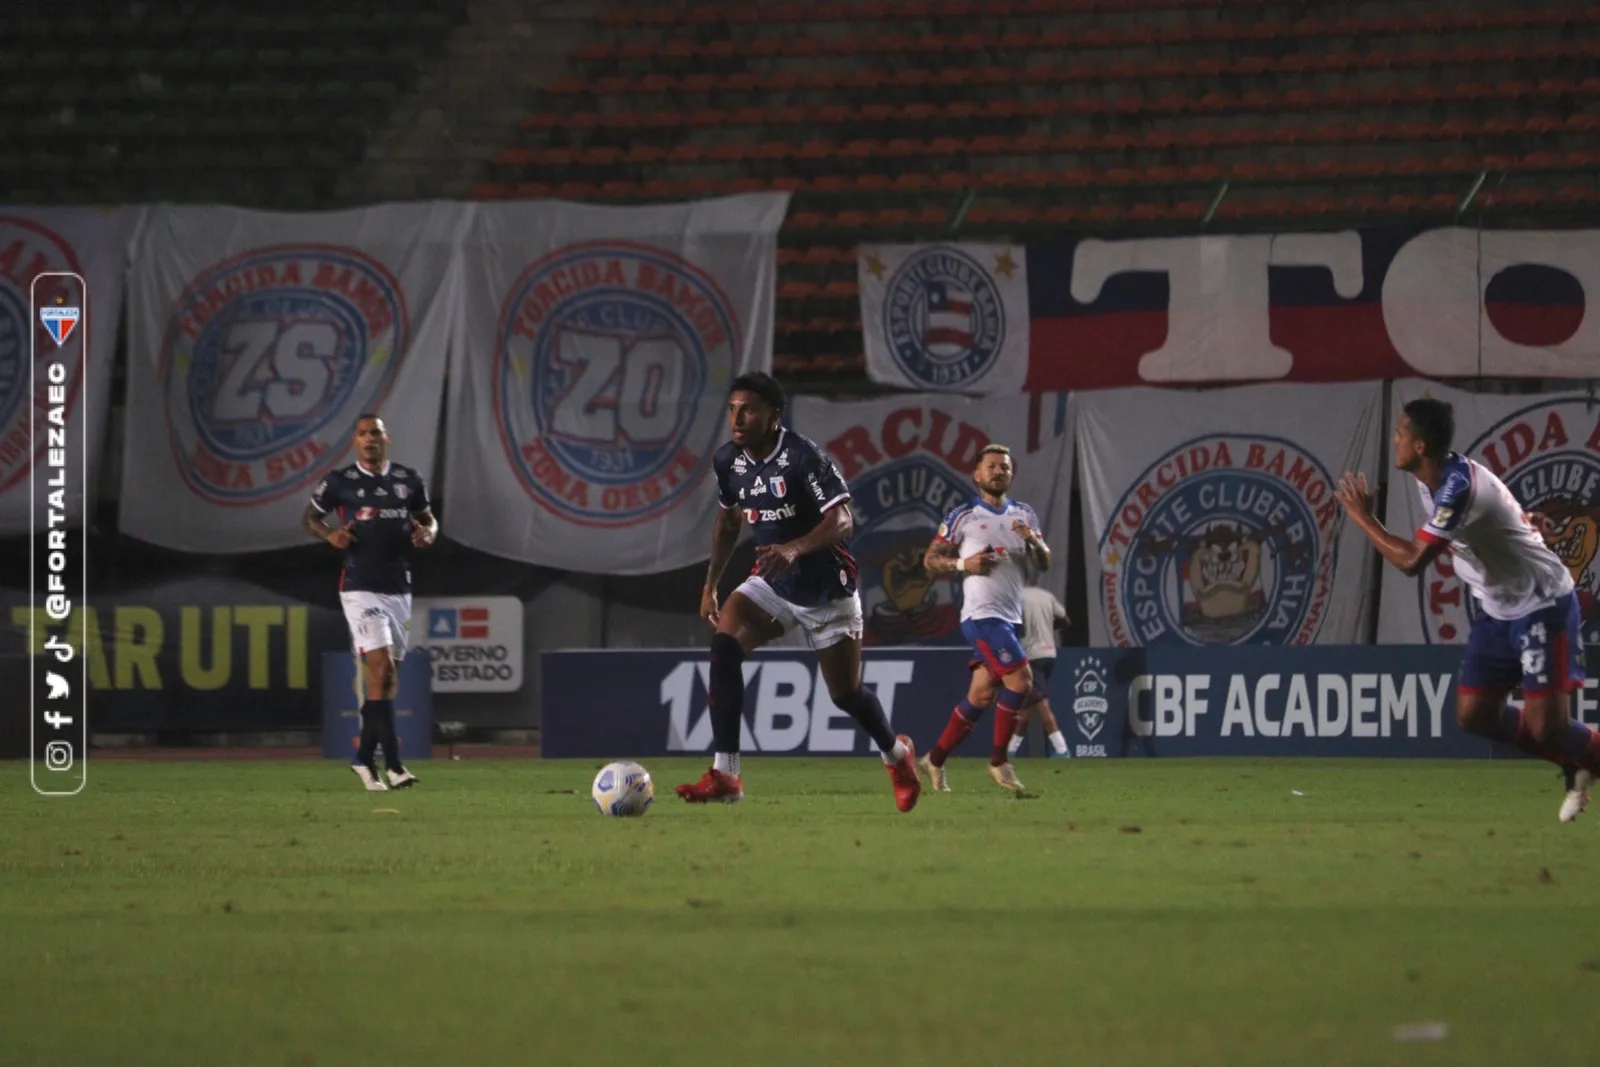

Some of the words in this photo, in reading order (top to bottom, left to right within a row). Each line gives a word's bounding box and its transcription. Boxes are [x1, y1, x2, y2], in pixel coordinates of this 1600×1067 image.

[511, 260, 627, 341] TORCIDA
[212, 320, 343, 420] ZS
[1108, 441, 1232, 547] TORCIDA
[1244, 444, 1337, 532] BAMOR
[1521, 462, 1600, 502] CLUBE
[1199, 483, 1290, 526] CLUBE
[1266, 520, 1307, 630] BHIA
[180, 604, 308, 690] UTI
[437, 665, 512, 681] ESTADO
[1128, 673, 1211, 737] CBF
[1220, 673, 1453, 738] ACADEMY
[1076, 744, 1107, 757] BRASIL
